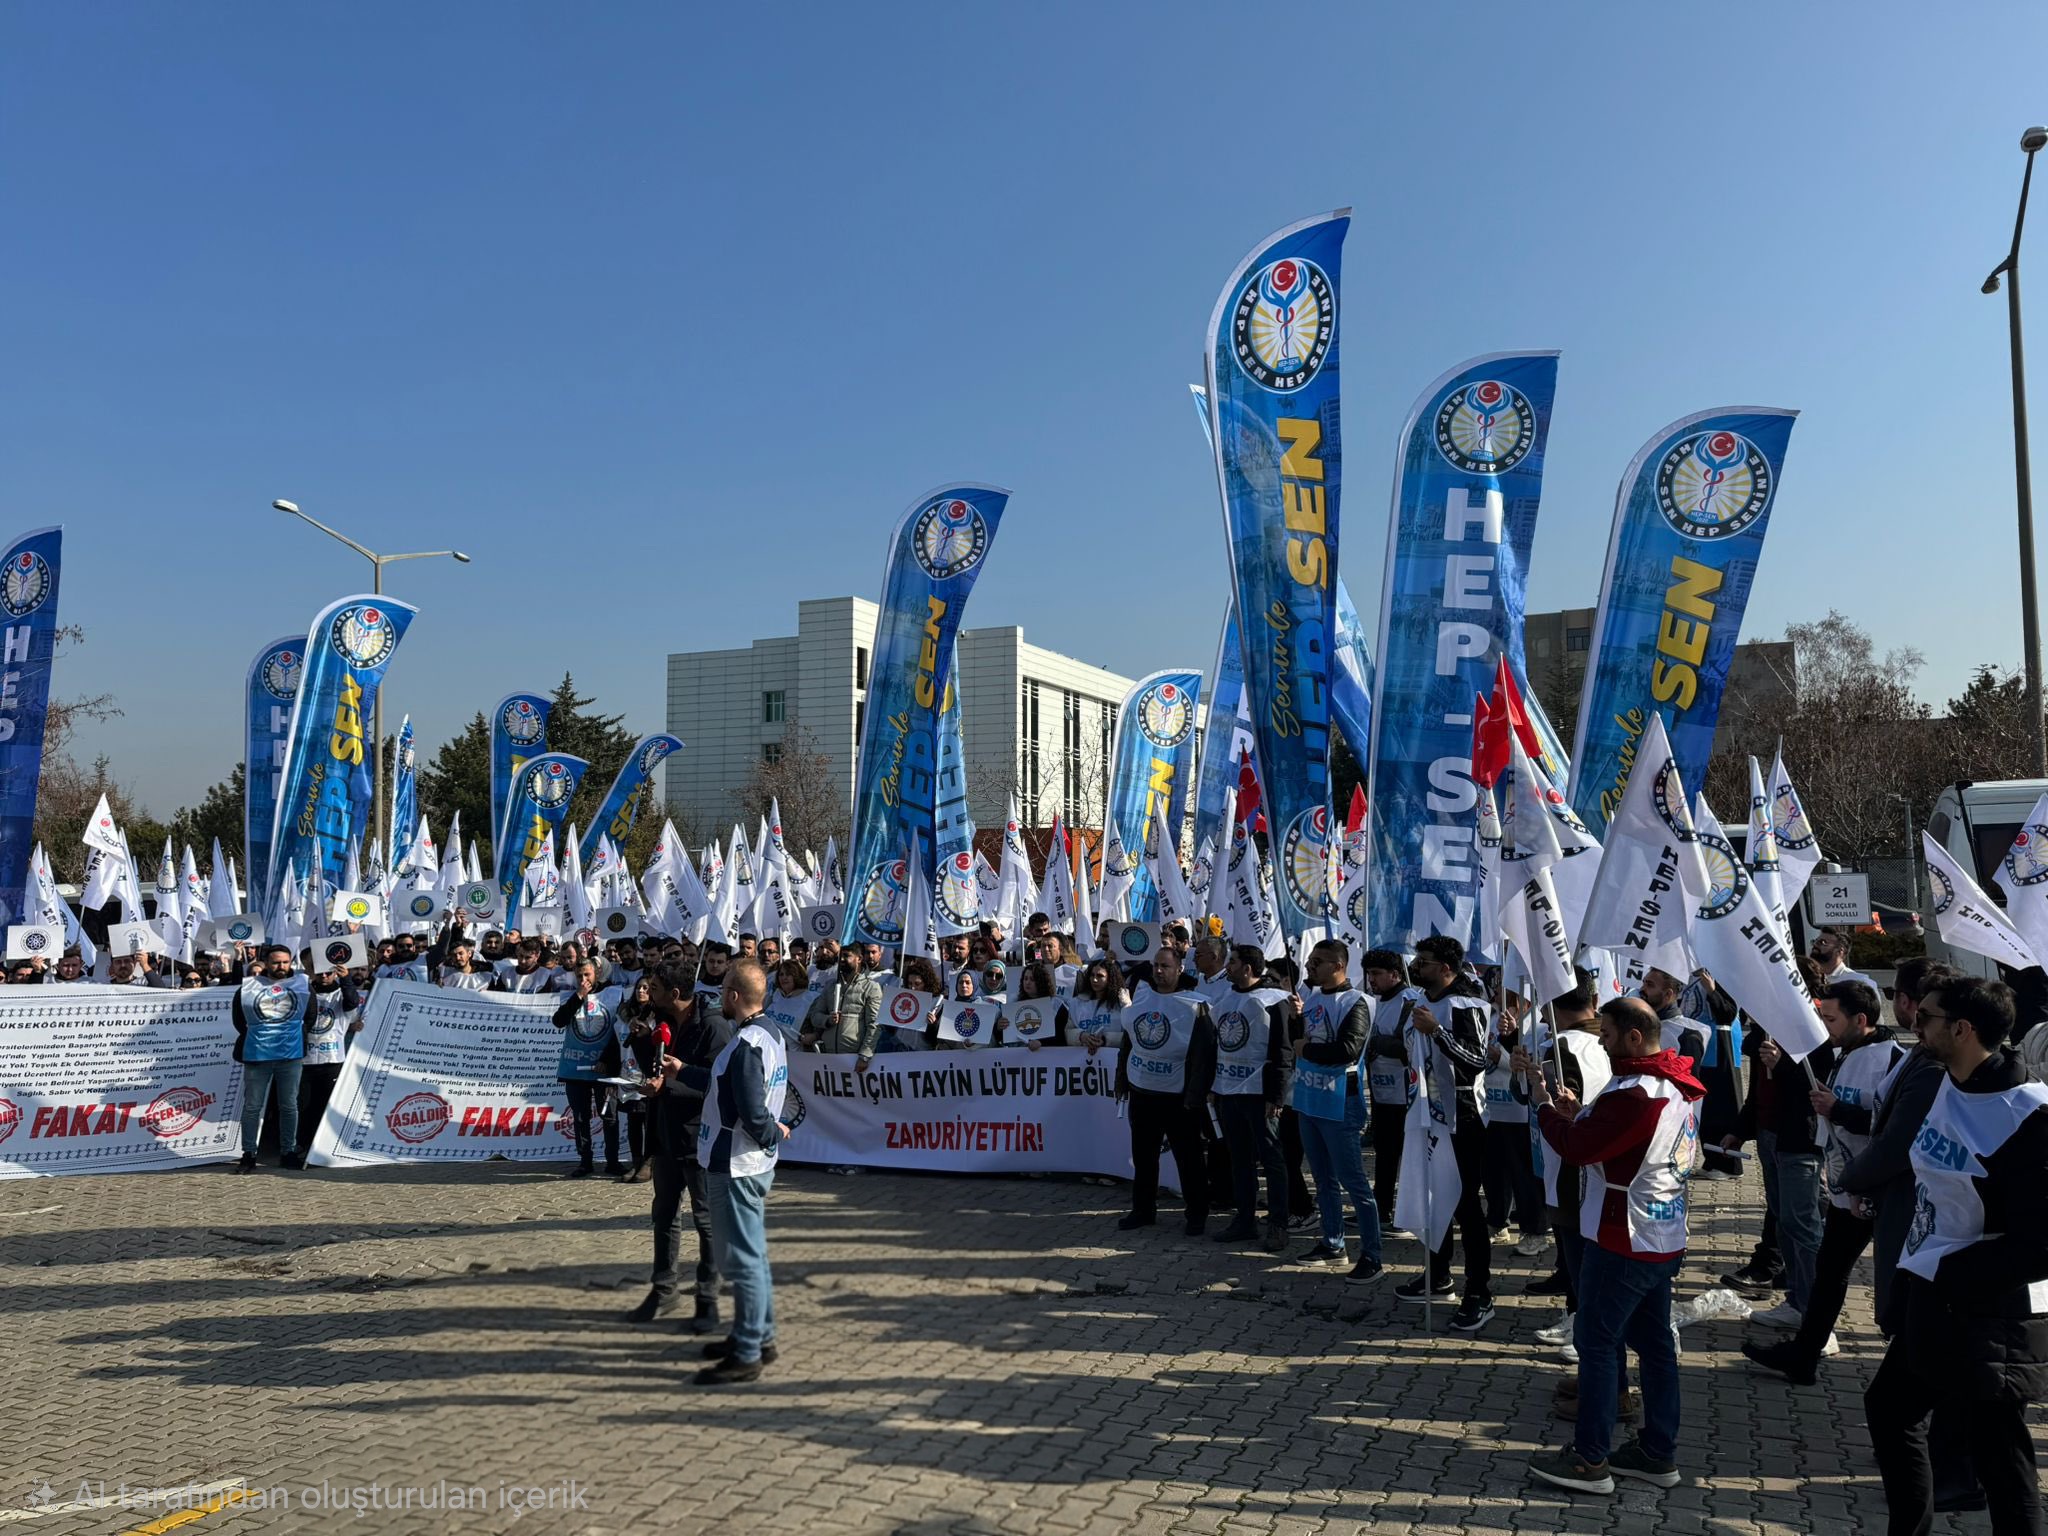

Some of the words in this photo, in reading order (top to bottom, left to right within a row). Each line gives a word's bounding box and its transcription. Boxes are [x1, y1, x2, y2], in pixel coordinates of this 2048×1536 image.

[1237, 289, 1267, 380] HEP-SEN
[1275, 371, 1305, 388] HEP
[1309, 275, 1331, 369] SENİNLE
[1439, 395, 1463, 461] HEP-SEN
[1466, 461, 1497, 472] HEP
[1505, 398, 1532, 466] SENİNLE
[1277, 416, 1327, 592] SEN
[1660, 443, 1691, 520] HEP-SEN
[1682, 522, 1720, 536] HEP
[1730, 456, 1767, 530] SENİNLE
[914, 508, 937, 567] HEP-SEN
[1652, 554, 1723, 711] SEN
[329, 673, 364, 766] SEN
[1624, 845, 1679, 950] HEP-SEN
[1825, 902, 1857, 910] ÖVEÇLER
[1832, 887, 1848, 898] 21
[1740, 916, 1819, 1012] HEP-SE
[98, 1019, 145, 1027] KURULU
[149, 1015, 218, 1026] BAŞKANLIĞI
[429, 1020, 520, 1033] YÜKSEKÖĞRETİM
[813, 1064, 856, 1098] AİLE
[858, 1065, 903, 1105] İÇİN
[908, 1062, 972, 1099] TAYİN
[979, 1062, 1048, 1097] LÜTUF
[29, 1101, 138, 1139] FAKAT
[385, 1105, 453, 1128] YASALDIR!
[457, 1106, 554, 1137] FAKAT
[884, 1114, 1044, 1152] ZARURİYETTİR!
